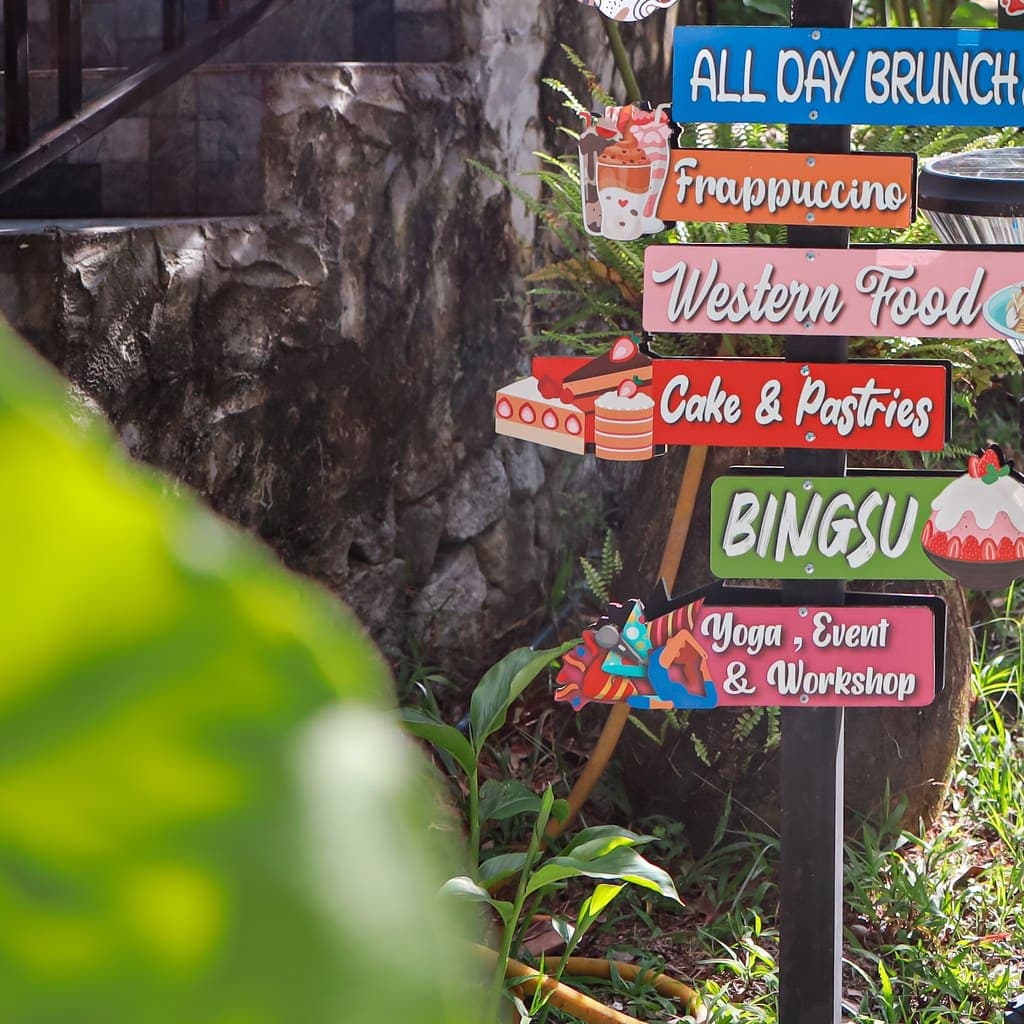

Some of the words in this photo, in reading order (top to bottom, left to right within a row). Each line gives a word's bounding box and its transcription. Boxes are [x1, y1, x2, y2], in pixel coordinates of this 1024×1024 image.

[691, 49, 766, 103] ALL
[777, 49, 855, 104] DAY
[866, 50, 1019, 105] BRUNCH
[673, 157, 907, 213] Frappuccino
[652, 259, 845, 325] Western
[855, 264, 985, 326] Food
[660, 374, 741, 425] Cake
[755, 380, 783, 425] &
[795, 375, 933, 438] Pastries
[722, 490, 918, 569] BINGSU
[701, 612, 781, 655] Yoga
[812, 612, 889, 649] Event
[723, 663, 756, 695] &
[767, 661, 916, 701] Workshop
